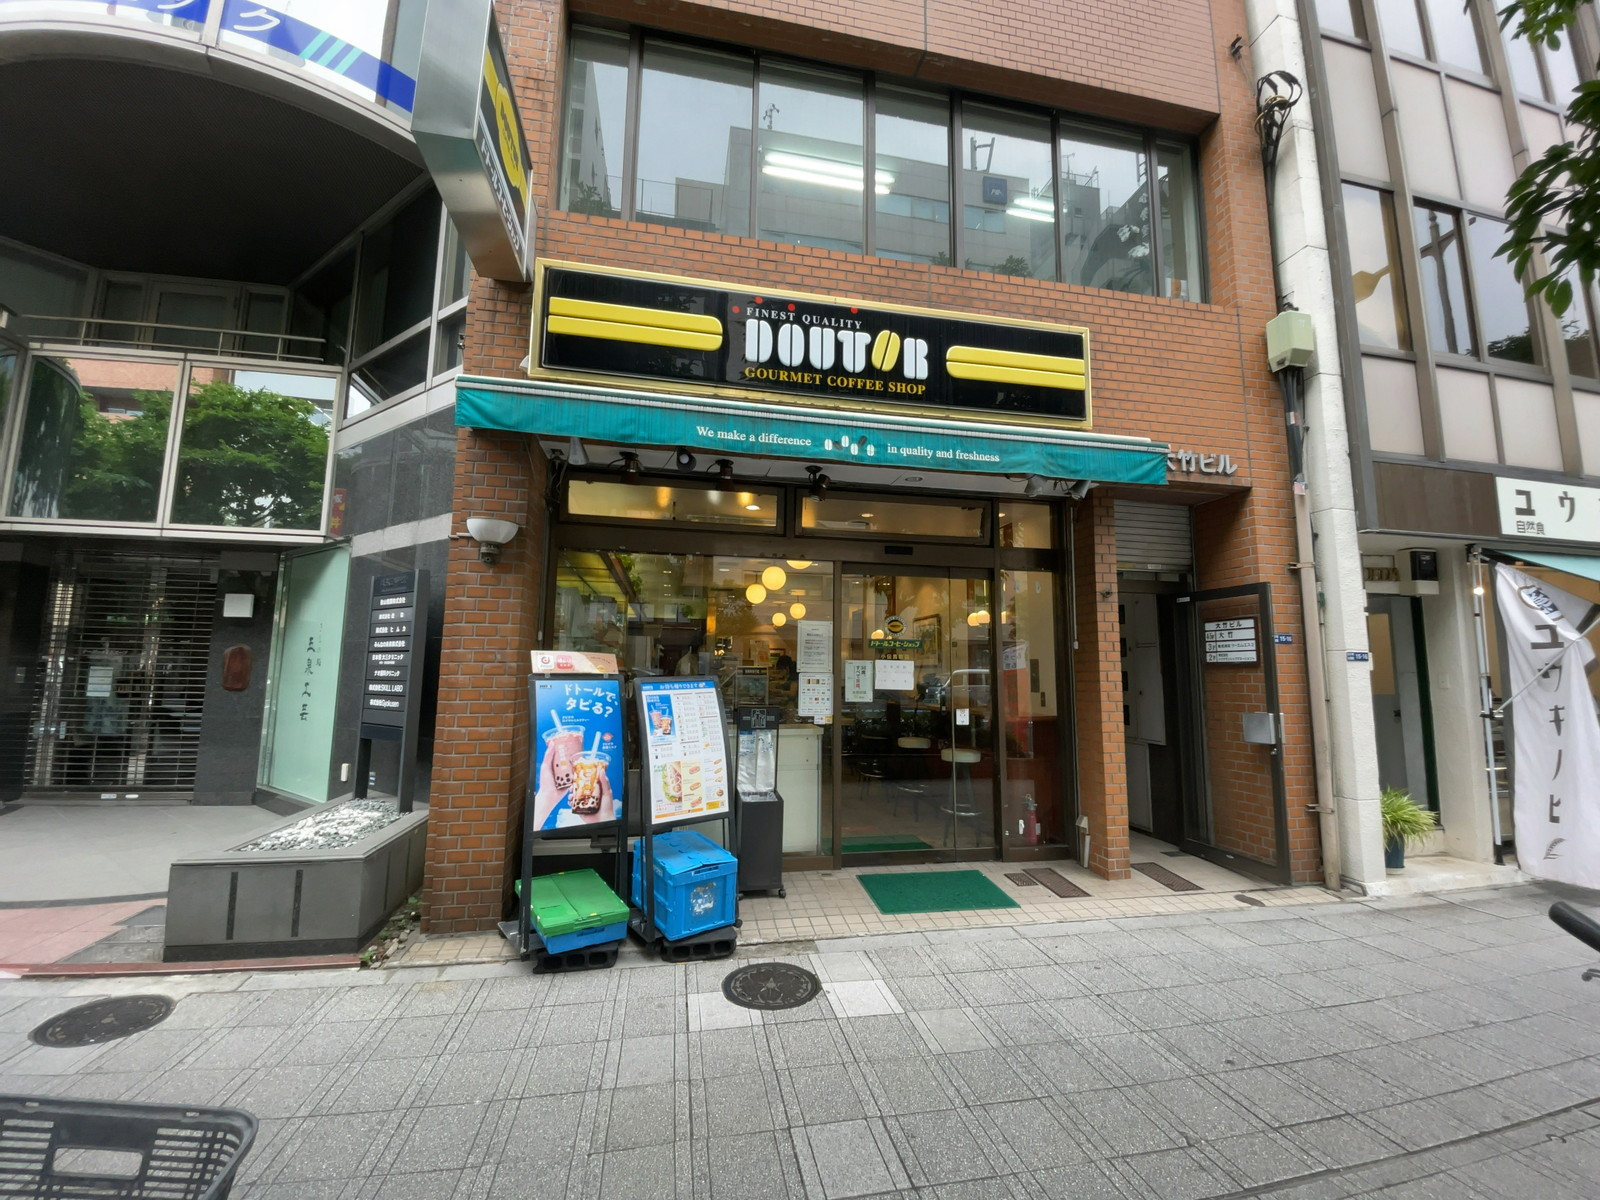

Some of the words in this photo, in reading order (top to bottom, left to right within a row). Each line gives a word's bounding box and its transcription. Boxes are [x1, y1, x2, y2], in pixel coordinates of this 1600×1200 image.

[746, 307, 796, 323] FINEST
[802, 313, 863, 330] QUALITY
[745, 319, 929, 380] DOUTOR
[745, 367, 822, 386] GOURMET
[827, 373, 884, 391] COFFEE
[888, 380, 927, 396] SHOP
[696, 426, 715, 439] We
[717, 428, 747, 442] make
[749, 434, 756, 443] a
[758, 430, 812, 447] difference
[887, 444, 898, 454] in
[900, 444, 934, 460] quality
[935, 447, 954, 460] and
[955, 448, 1000, 463] freshness
[1515, 489, 1600, 523] ユウ
[1516, 520, 1546, 535] 自然食
[1215, 621, 1243, 629] 大竹ビル
[564, 683, 618, 706] ドトールで、
[1530, 624, 1565, 824] ユウキノヒ
